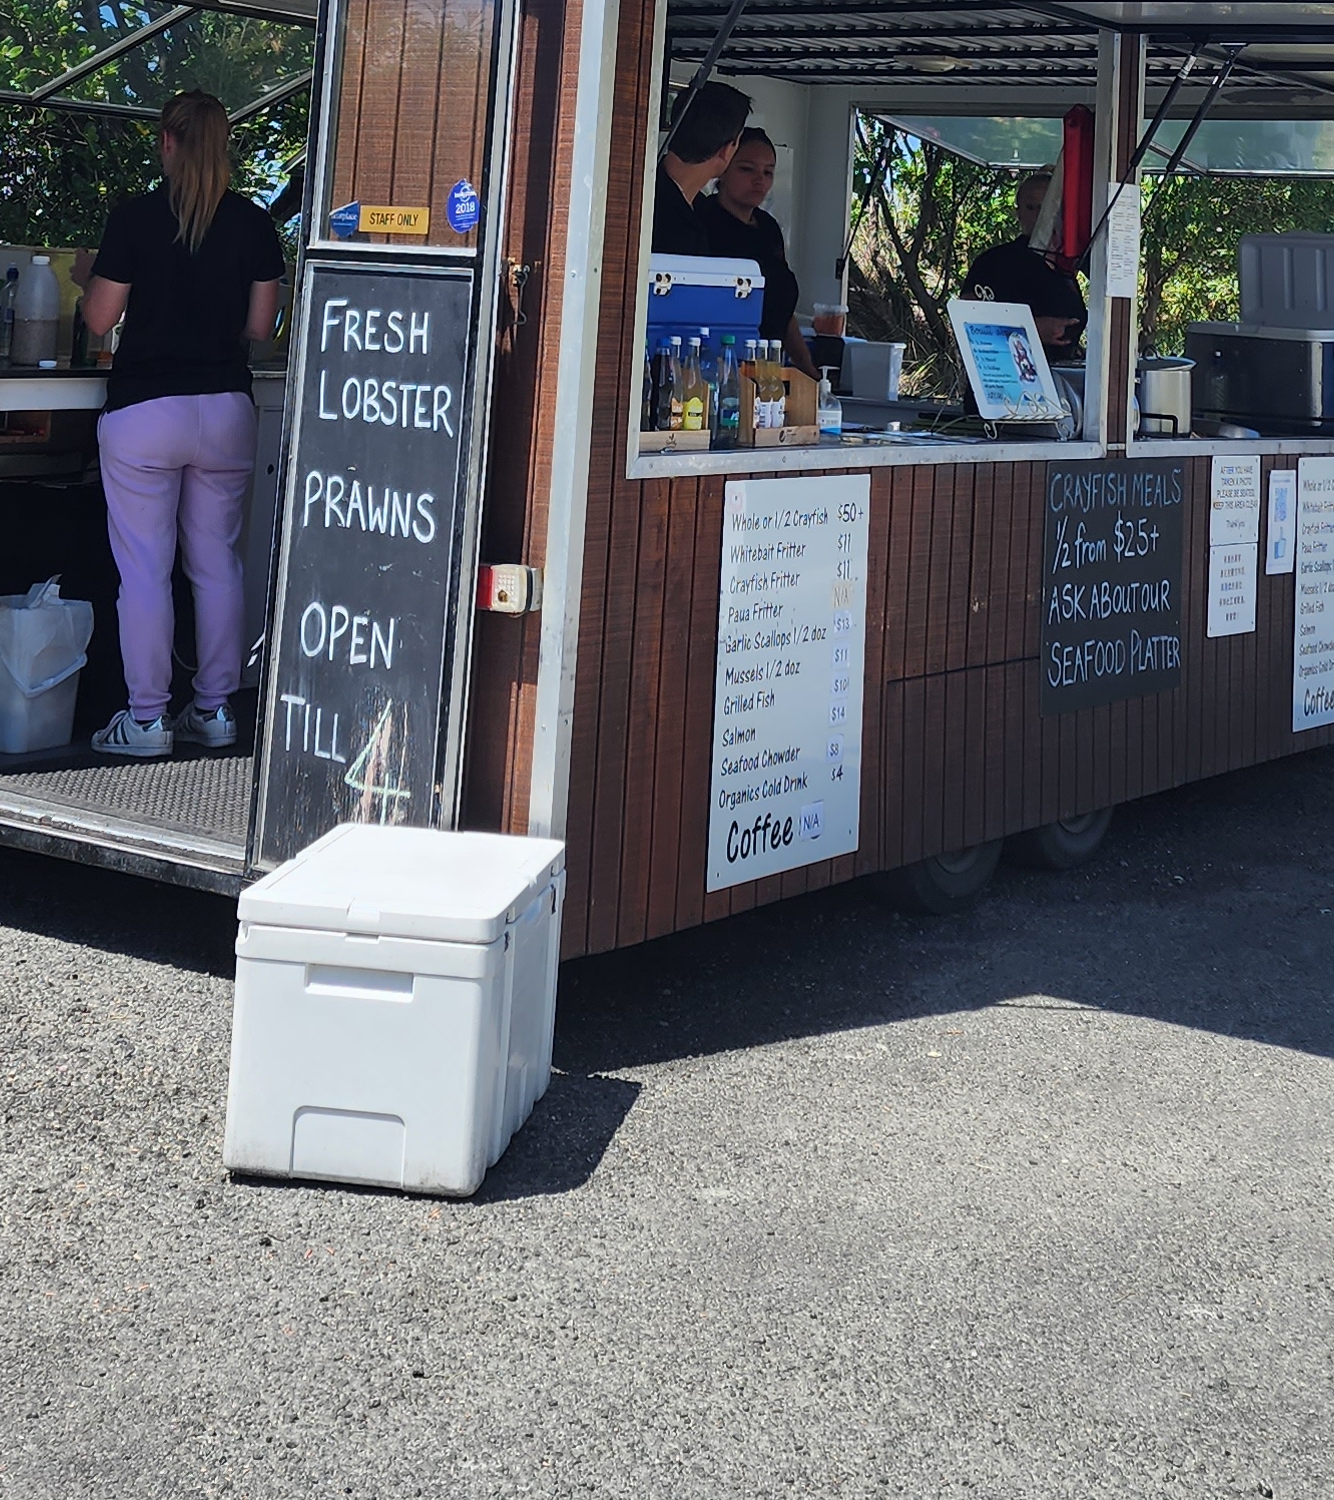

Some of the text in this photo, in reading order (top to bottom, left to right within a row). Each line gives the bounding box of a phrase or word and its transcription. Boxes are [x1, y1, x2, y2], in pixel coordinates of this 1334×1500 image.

[369, 212, 394, 225] STAFF
[397, 213, 418, 227] ONLY
[455, 201, 475, 214] 2018
[320, 299, 430, 356] FRESH
[318, 377, 454, 438] LOBSTER
[303, 469, 436, 544] PRAWNS
[1050, 468, 1182, 512] CRAYFISH MEALS
[732, 513, 760, 531] Whole
[763, 517, 772, 528] or
[775, 509, 791, 529] 1/2
[793, 507, 828, 529] Crayfish
[1075, 521, 1107, 569] from
[1114, 511, 1160, 562] $25+
[730, 533, 851, 564] Whitebait Fritter $11
[730, 559, 850, 595] Crayfish Fritter $11
[728, 607, 750, 624] Paua
[752, 602, 783, 620] Fritter
[1048, 580, 1171, 625] ASK ABOUT OUR
[301, 601, 395, 669] OPEN
[725, 633, 752, 654] Garlic
[754, 630, 791, 651] Scallops
[793, 625, 809, 645] 1/2
[811, 627, 827, 641] doz
[725, 663, 763, 687] Mussels
[766, 659, 782, 680] 1/2
[784, 659, 801, 675] doz
[1047, 629, 1181, 688] SEAFOOD PLATTER
[724, 692, 754, 716] Grilled
[757, 688, 775, 709] Fish
[280, 694, 346, 764] TILL
[722, 707, 845, 747] Salmon $14
[721, 751, 759, 776] Seafood
[762, 745, 801, 768] Chowder
[719, 765, 843, 811] Organics Cold Drink $4
[726, 812, 820, 863] Coffee N/A
